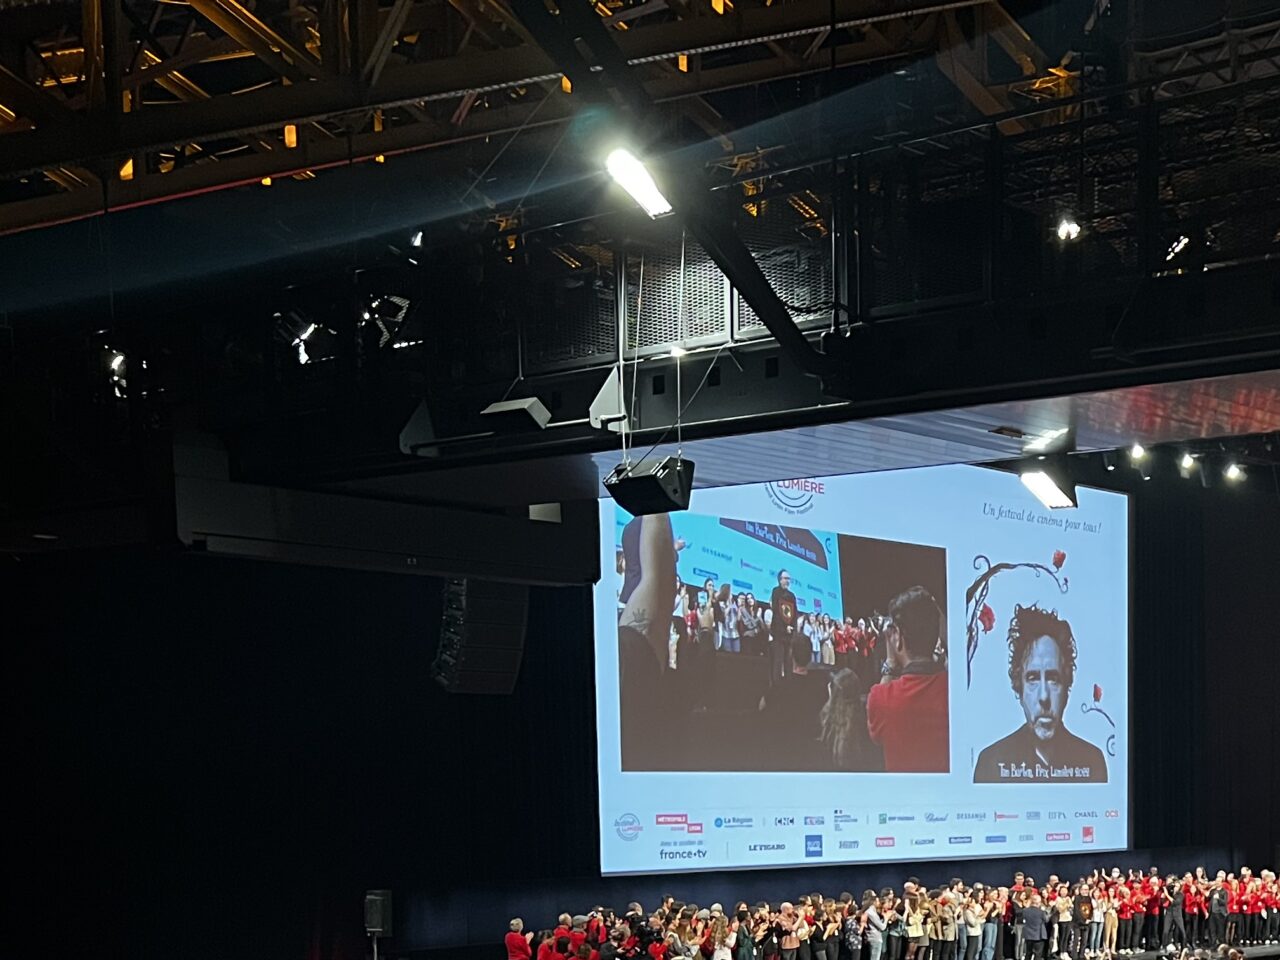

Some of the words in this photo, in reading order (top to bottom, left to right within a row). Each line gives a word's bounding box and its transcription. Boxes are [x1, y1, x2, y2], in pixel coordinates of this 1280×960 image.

[983, 502, 996, 516] Un
[996, 505, 1025, 521] festival
[1026, 510, 1035, 523] de
[1036, 515, 1063, 528] cinéma
[1064, 518, 1081, 532] pour
